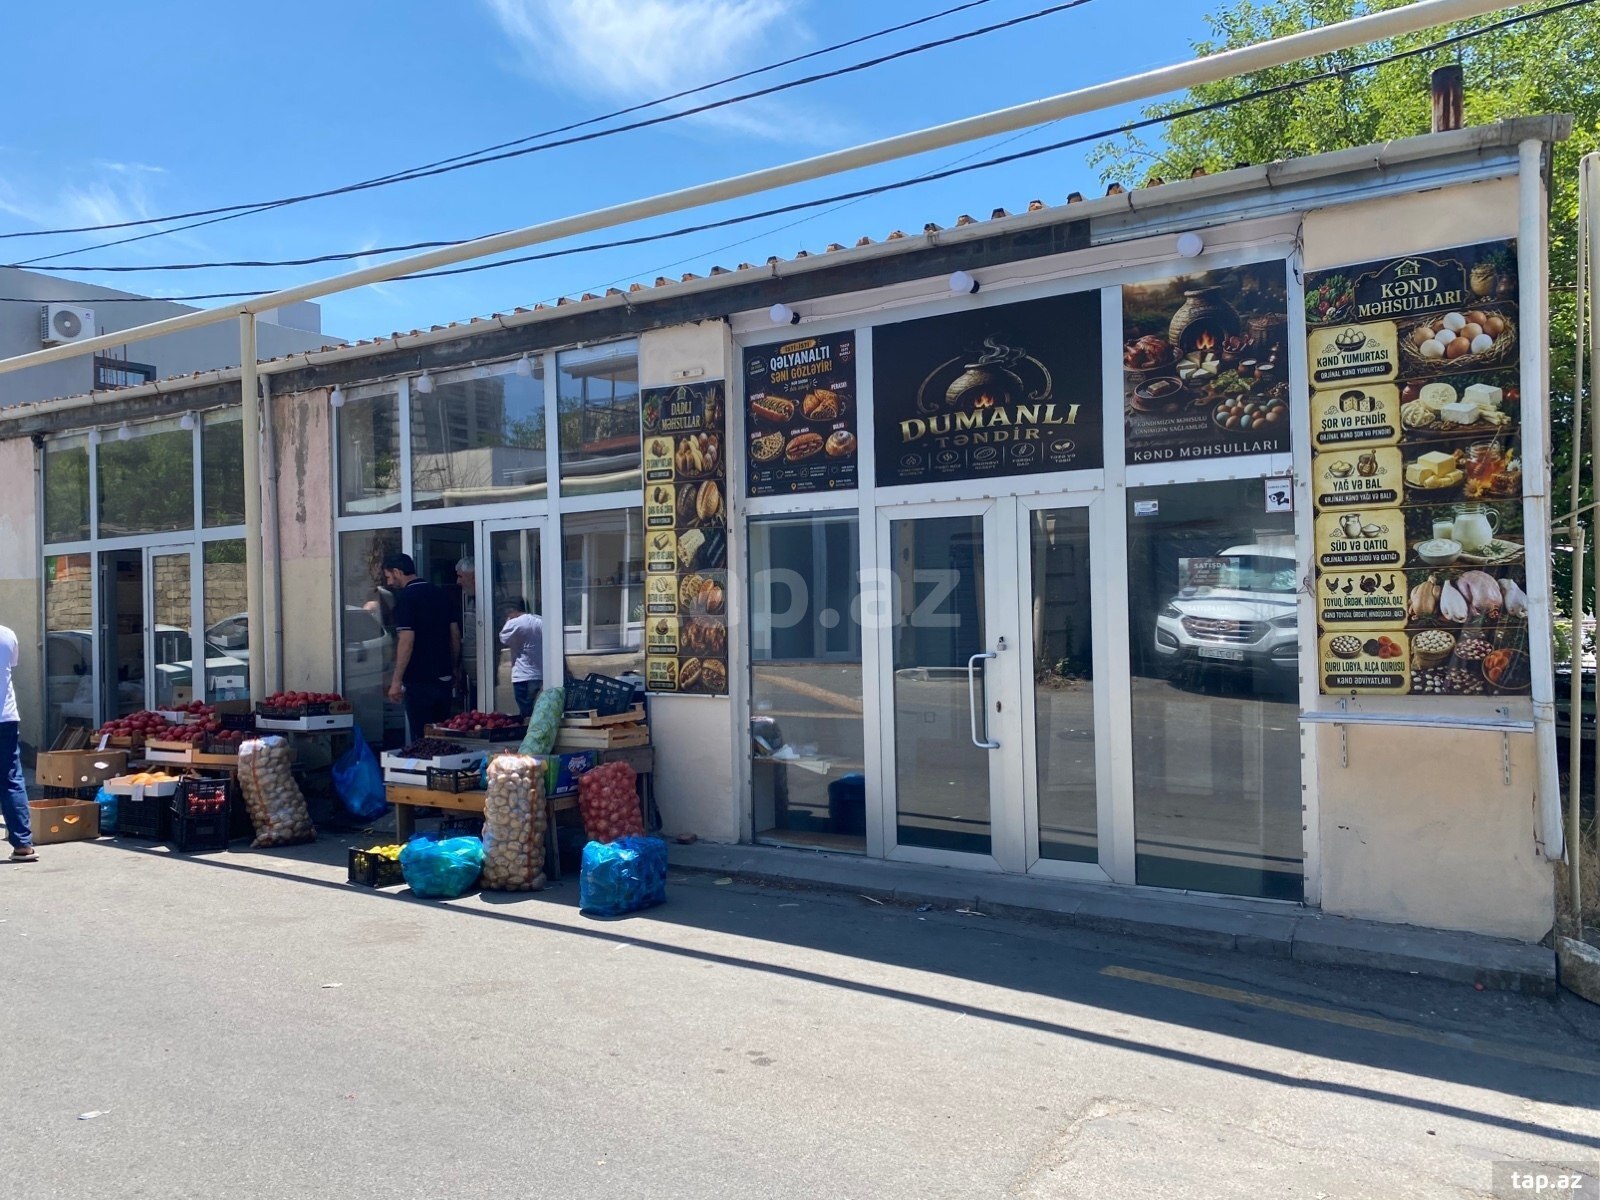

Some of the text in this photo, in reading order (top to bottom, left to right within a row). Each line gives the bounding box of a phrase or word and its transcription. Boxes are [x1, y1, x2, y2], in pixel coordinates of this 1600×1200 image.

[1381, 276, 1438, 299] KƏND
[1358, 290, 1461, 318] MƏHSULLARI
[770, 345, 830, 372] QƏLYANALTI
[1317, 350, 1388, 367] KƏND YUMURTASI
[771, 360, 833, 384] SƏNİ GÖZLƏYİR!
[1357, 366, 1385, 375] YUMURTASI
[671, 401, 692, 416] DADLI
[899, 404, 1081, 444] DUMANLI
[1322, 412, 1386, 431] ŞOR VƏ PENDİR
[935, 427, 1040, 448] TƏNDİR
[1134, 440, 1278, 461] KƏND MƏHSULLARI
[1333, 479, 1382, 491] YAĞ VƏ BAL
[1331, 539, 1388, 551] SÜD VƏ QATIQ
[1393, 596, 1403, 605] QAZ
[1325, 662, 1340, 672] QURU
[1365, 662, 1379, 673] ALÇA
[1381, 662, 1405, 672] QURUSU
